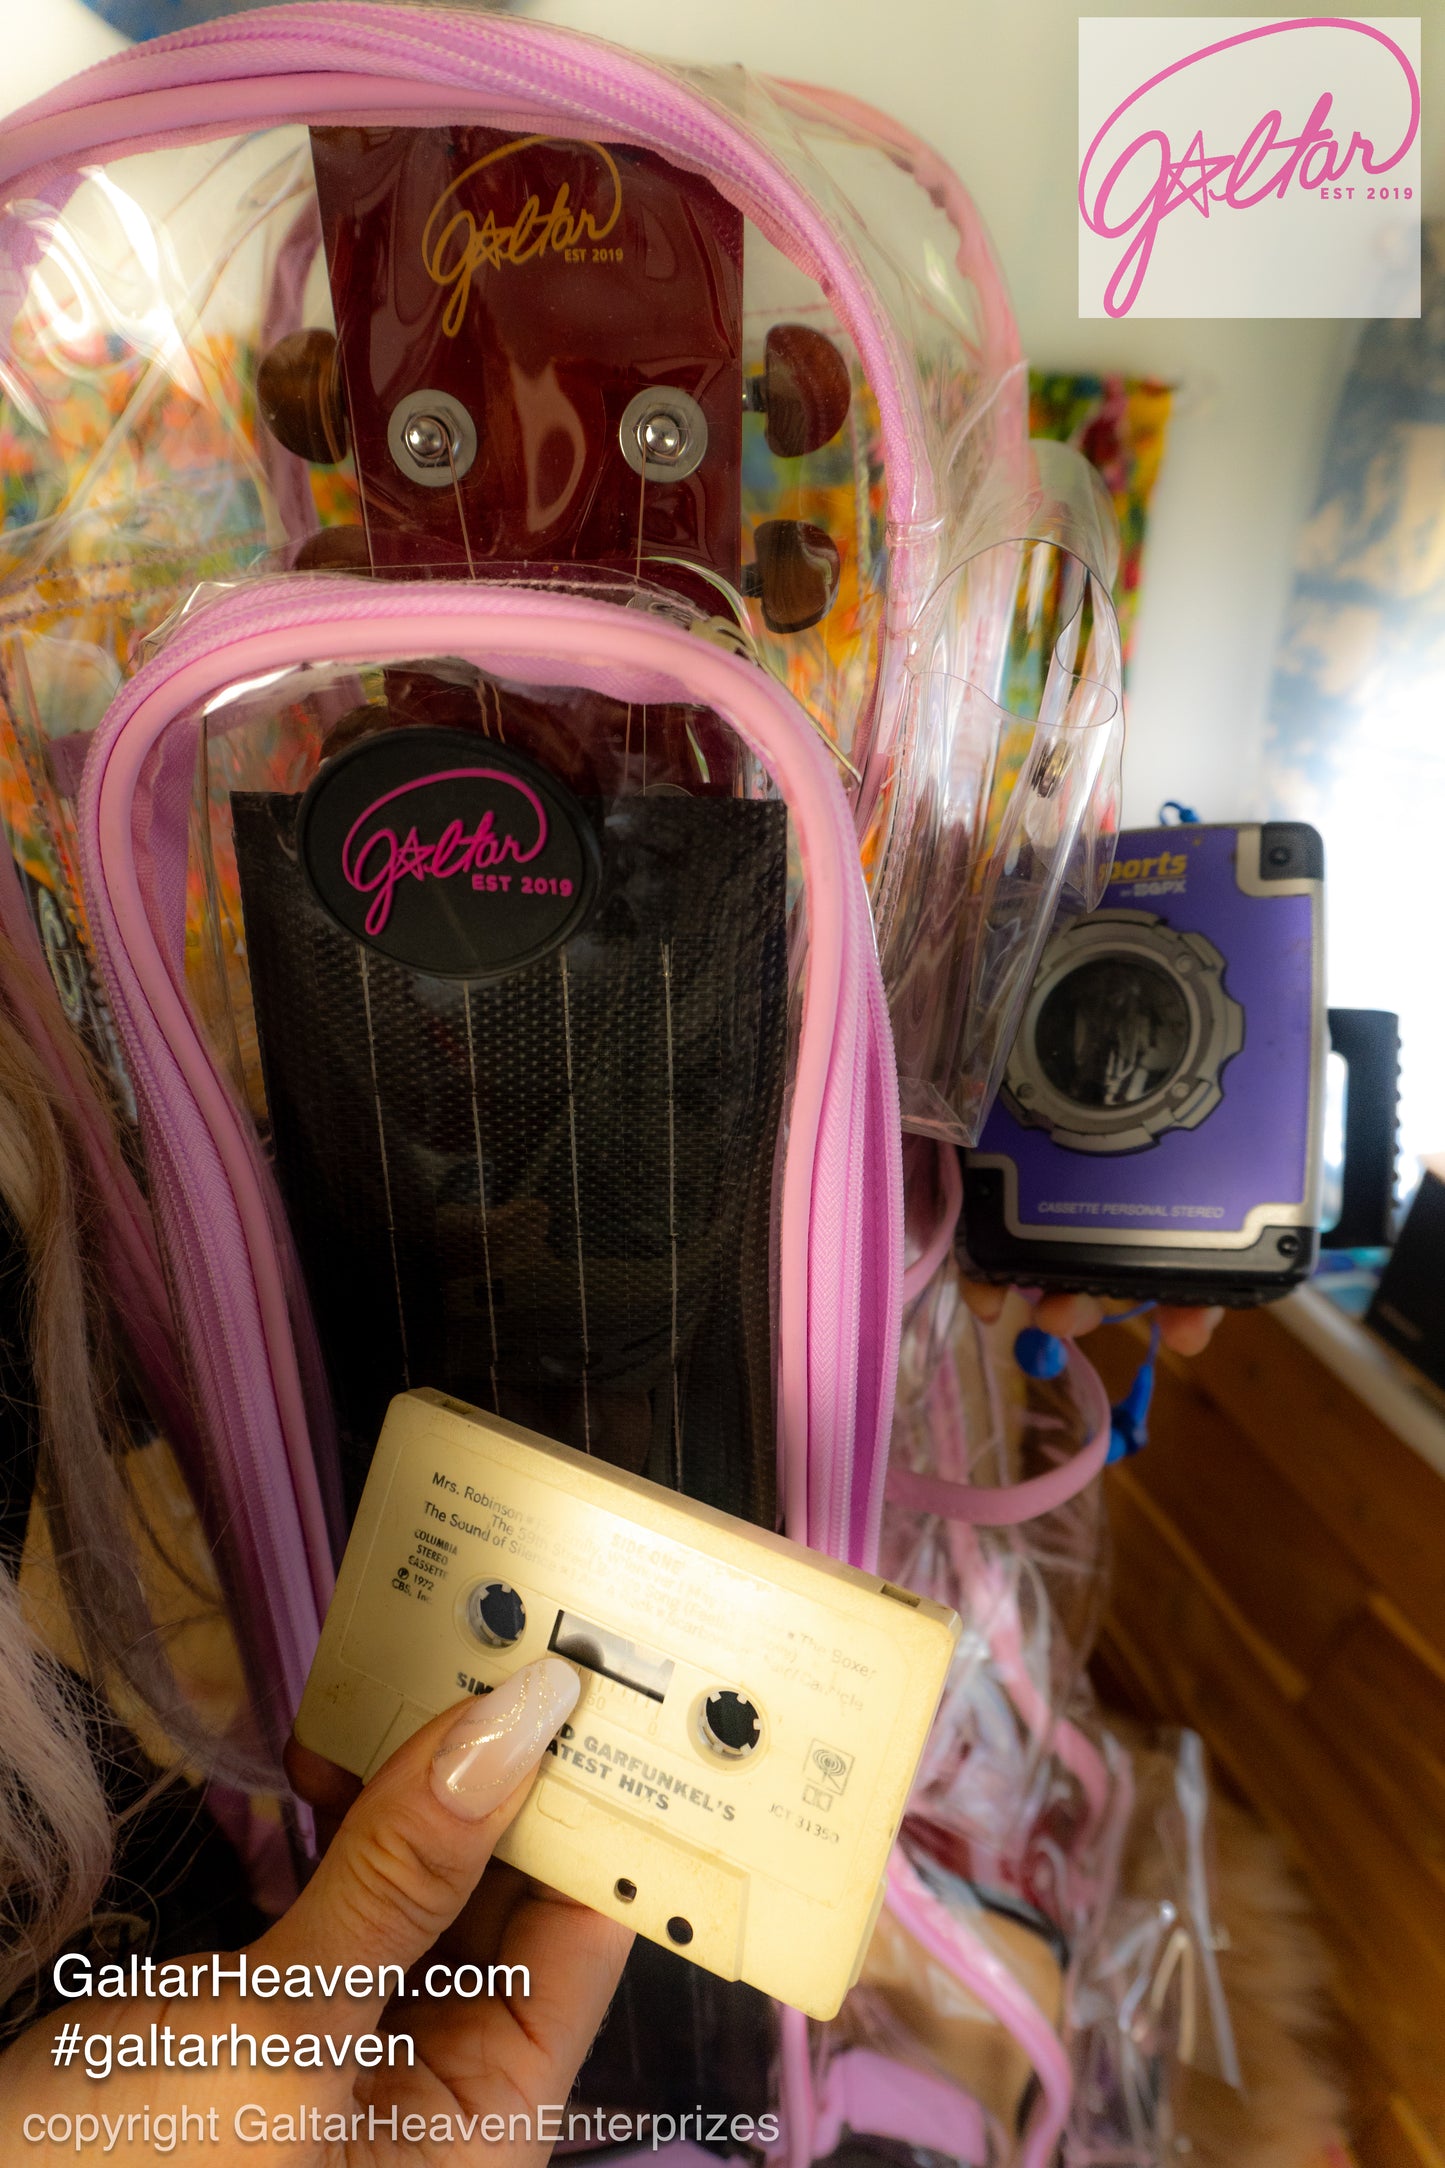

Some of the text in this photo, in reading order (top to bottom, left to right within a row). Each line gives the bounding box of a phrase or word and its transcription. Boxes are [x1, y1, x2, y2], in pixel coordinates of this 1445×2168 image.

[564, 248, 624, 262] EST 2019
[471, 874, 574, 897] EST 2019
[1037, 1201, 1225, 1218] CASSETTE PERSONAL STEREO
[431, 1471, 460, 1496] Mrs.
[463, 1485, 524, 1523] Robinson
[424, 1500, 447, 1523] The
[449, 1513, 492, 1542] Sound
[492, 1535, 508, 1549] of
[487, 1513, 514, 1536] The
[413, 1528, 458, 1556] COLUMBIA
[416, 1543, 449, 1566] STEREO
[414, 1573, 435, 1592] 1972
[544, 1737, 670, 1811] ATEST HITS
[585, 1736, 737, 1823] GARFUNKEL'S
